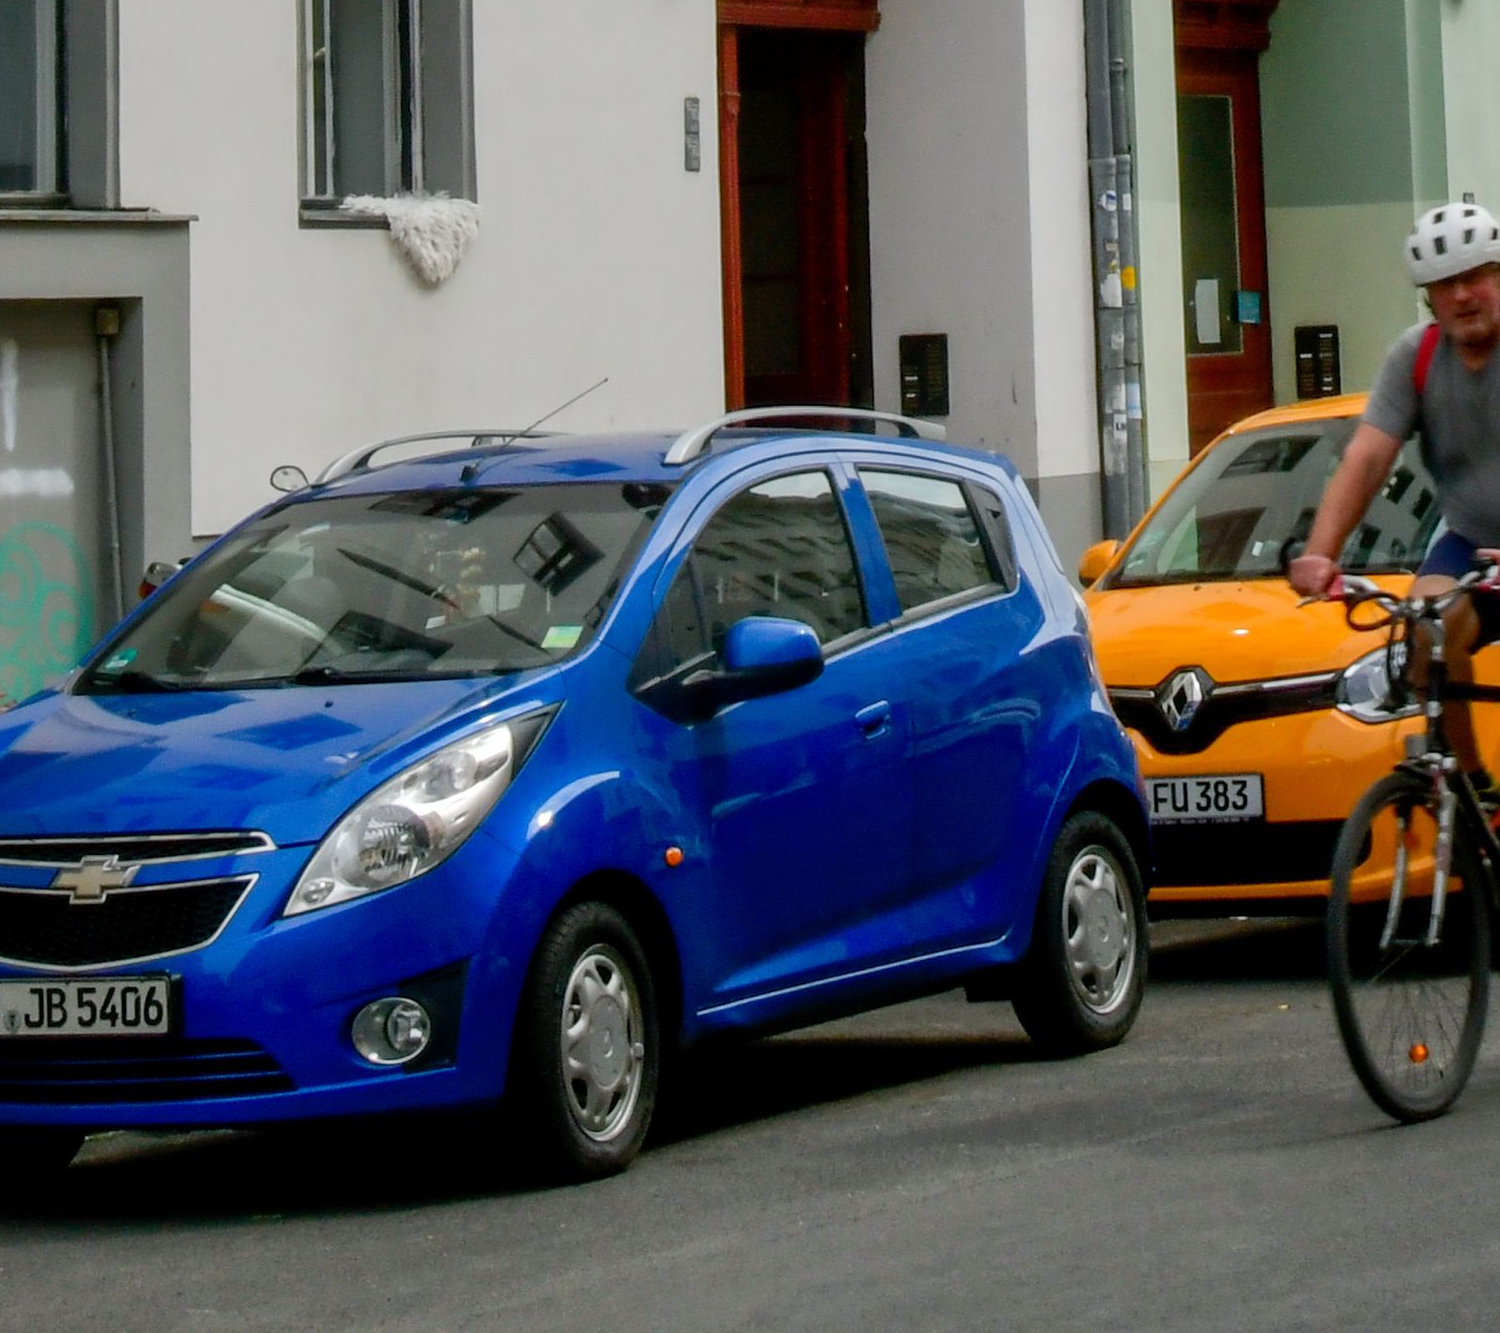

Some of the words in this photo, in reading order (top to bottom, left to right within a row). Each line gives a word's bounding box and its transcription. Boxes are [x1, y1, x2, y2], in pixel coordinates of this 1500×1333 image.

[1153, 782, 1189, 813] FU
[1195, 780, 1248, 812] 383
[24, 987, 68, 1028] JB
[77, 986, 164, 1027] 5406
